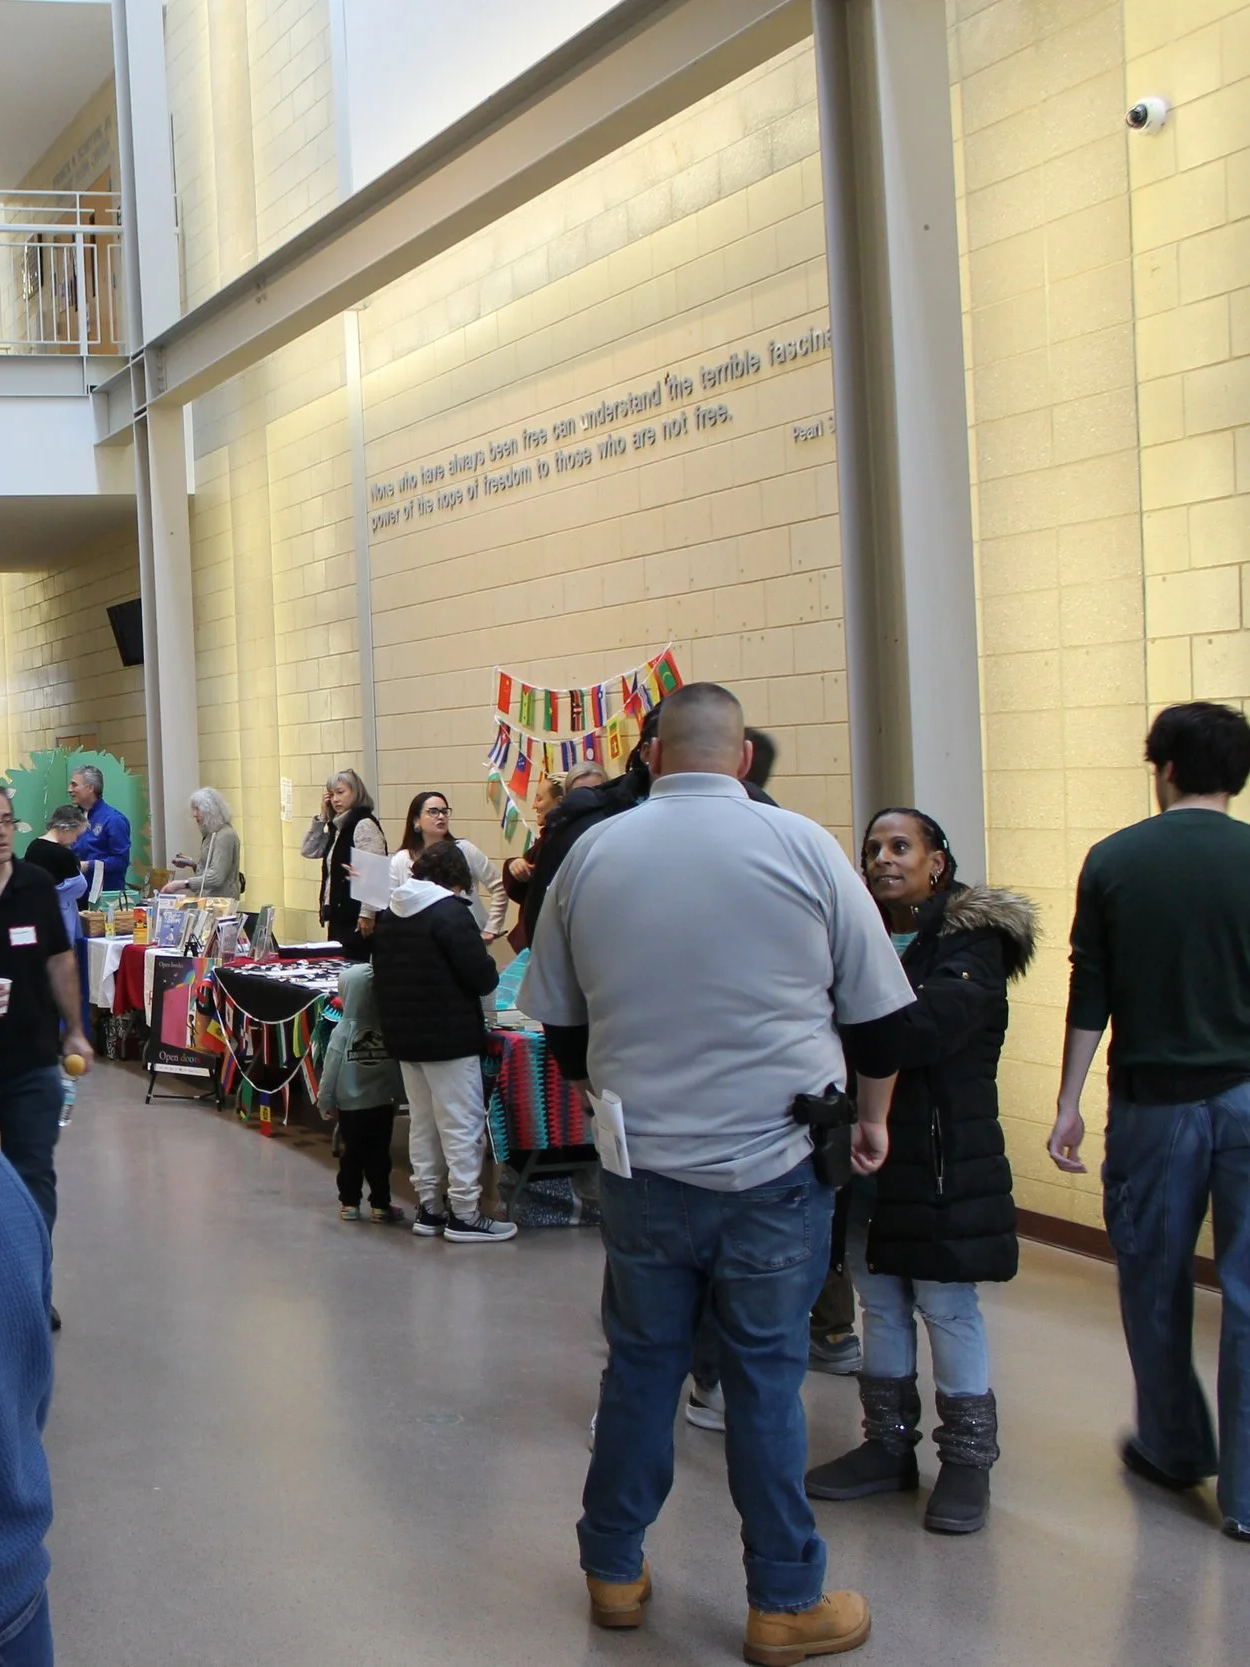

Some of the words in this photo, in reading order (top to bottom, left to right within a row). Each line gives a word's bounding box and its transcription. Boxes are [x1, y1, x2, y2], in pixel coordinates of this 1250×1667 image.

[370, 482, 394, 503] None
[397, 472, 418, 494] who
[420, 463, 445, 486] have
[448, 449, 486, 476] always
[489, 437, 519, 462] been
[522, 427, 548, 450] free
[552, 417, 576, 441] can
[579, 381, 662, 431] understand
[667, 373, 693, 401] the
[700, 349, 761, 390] terrible
[793, 420, 824, 443] Pearl
[371, 508, 400, 533] power
[403, 501, 415, 521] of
[417, 495, 434, 517] the
[437, 486, 463, 512] hope
[467, 479, 479, 501] of
[484, 462, 532, 496] freedom
[536, 457, 550, 479] to
[554, 446, 592, 473] those
[597, 433, 627, 460] who
[632, 425, 656, 450] are
[662, 410, 688, 441] not
[694, 403, 733, 431] free.
[158, 1050, 179, 1063] Open
[181, 1052, 202, 1063] doors
